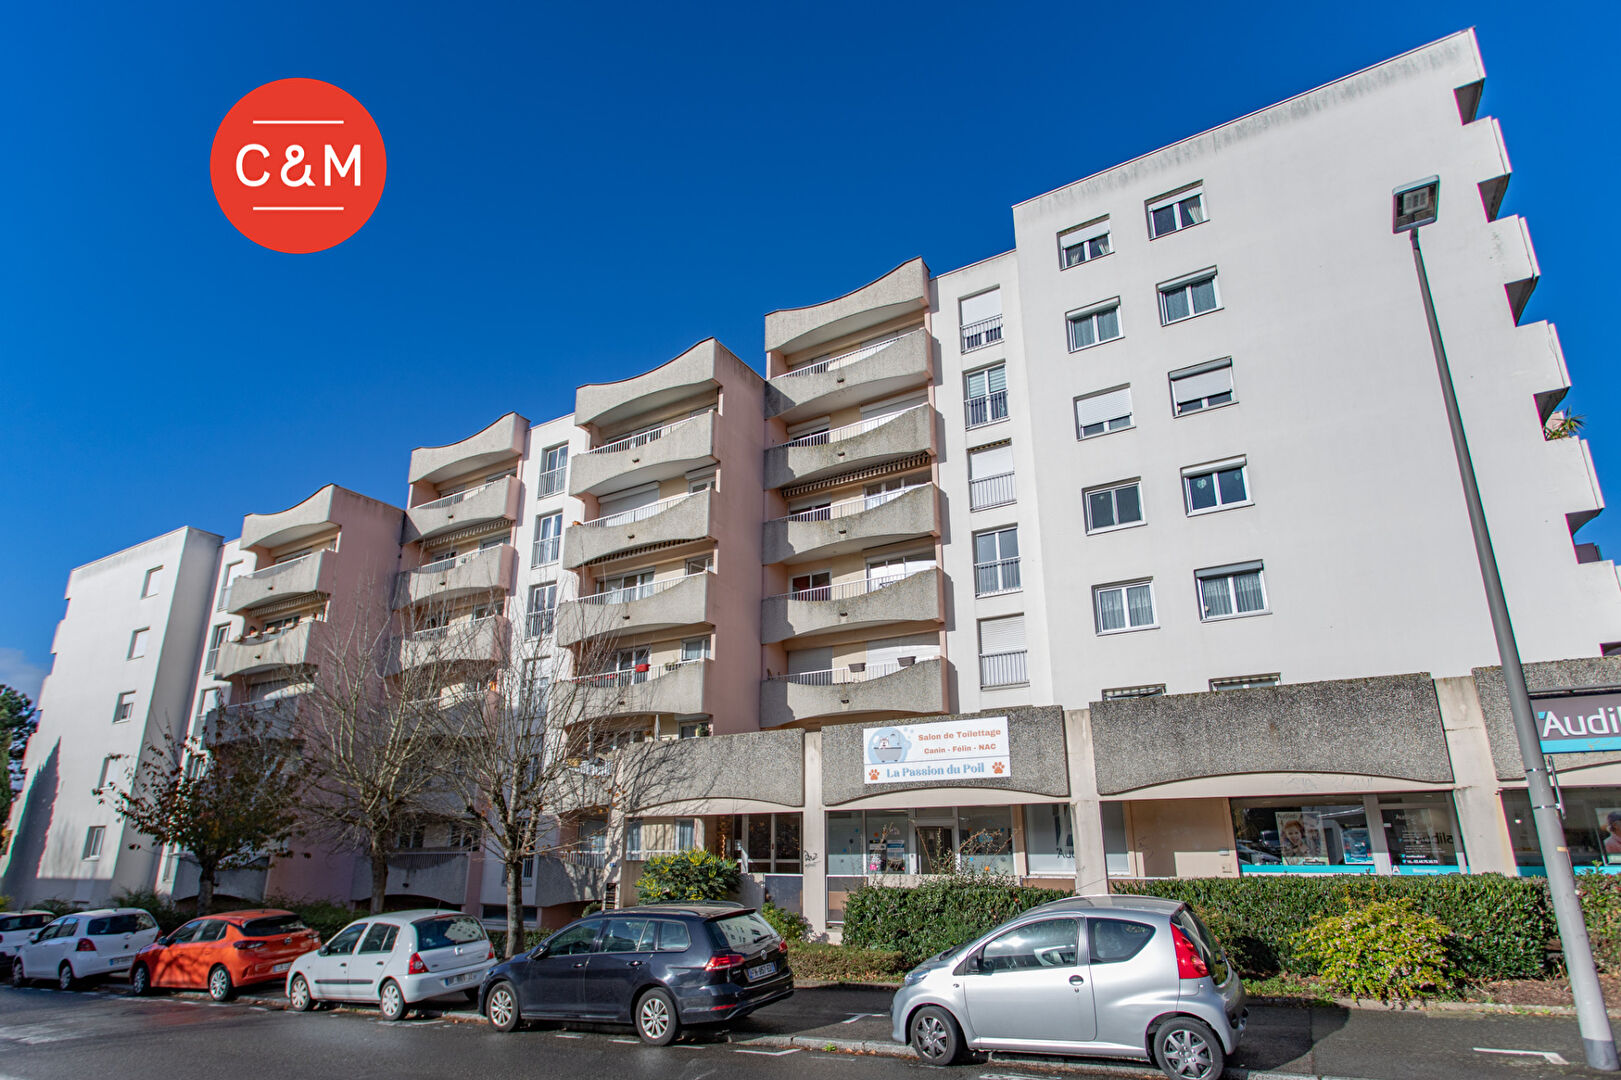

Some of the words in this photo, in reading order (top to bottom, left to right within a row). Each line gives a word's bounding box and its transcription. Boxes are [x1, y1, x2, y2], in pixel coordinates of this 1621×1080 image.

[957, 729, 1001, 738] Toilettage
[924, 746, 946, 754] Canin
[978, 743, 996, 751] NAC
[886, 768, 900, 778] La
[902, 765, 944, 777] Passion
[946, 764, 960, 775] du
[963, 762, 985, 773] Poil
